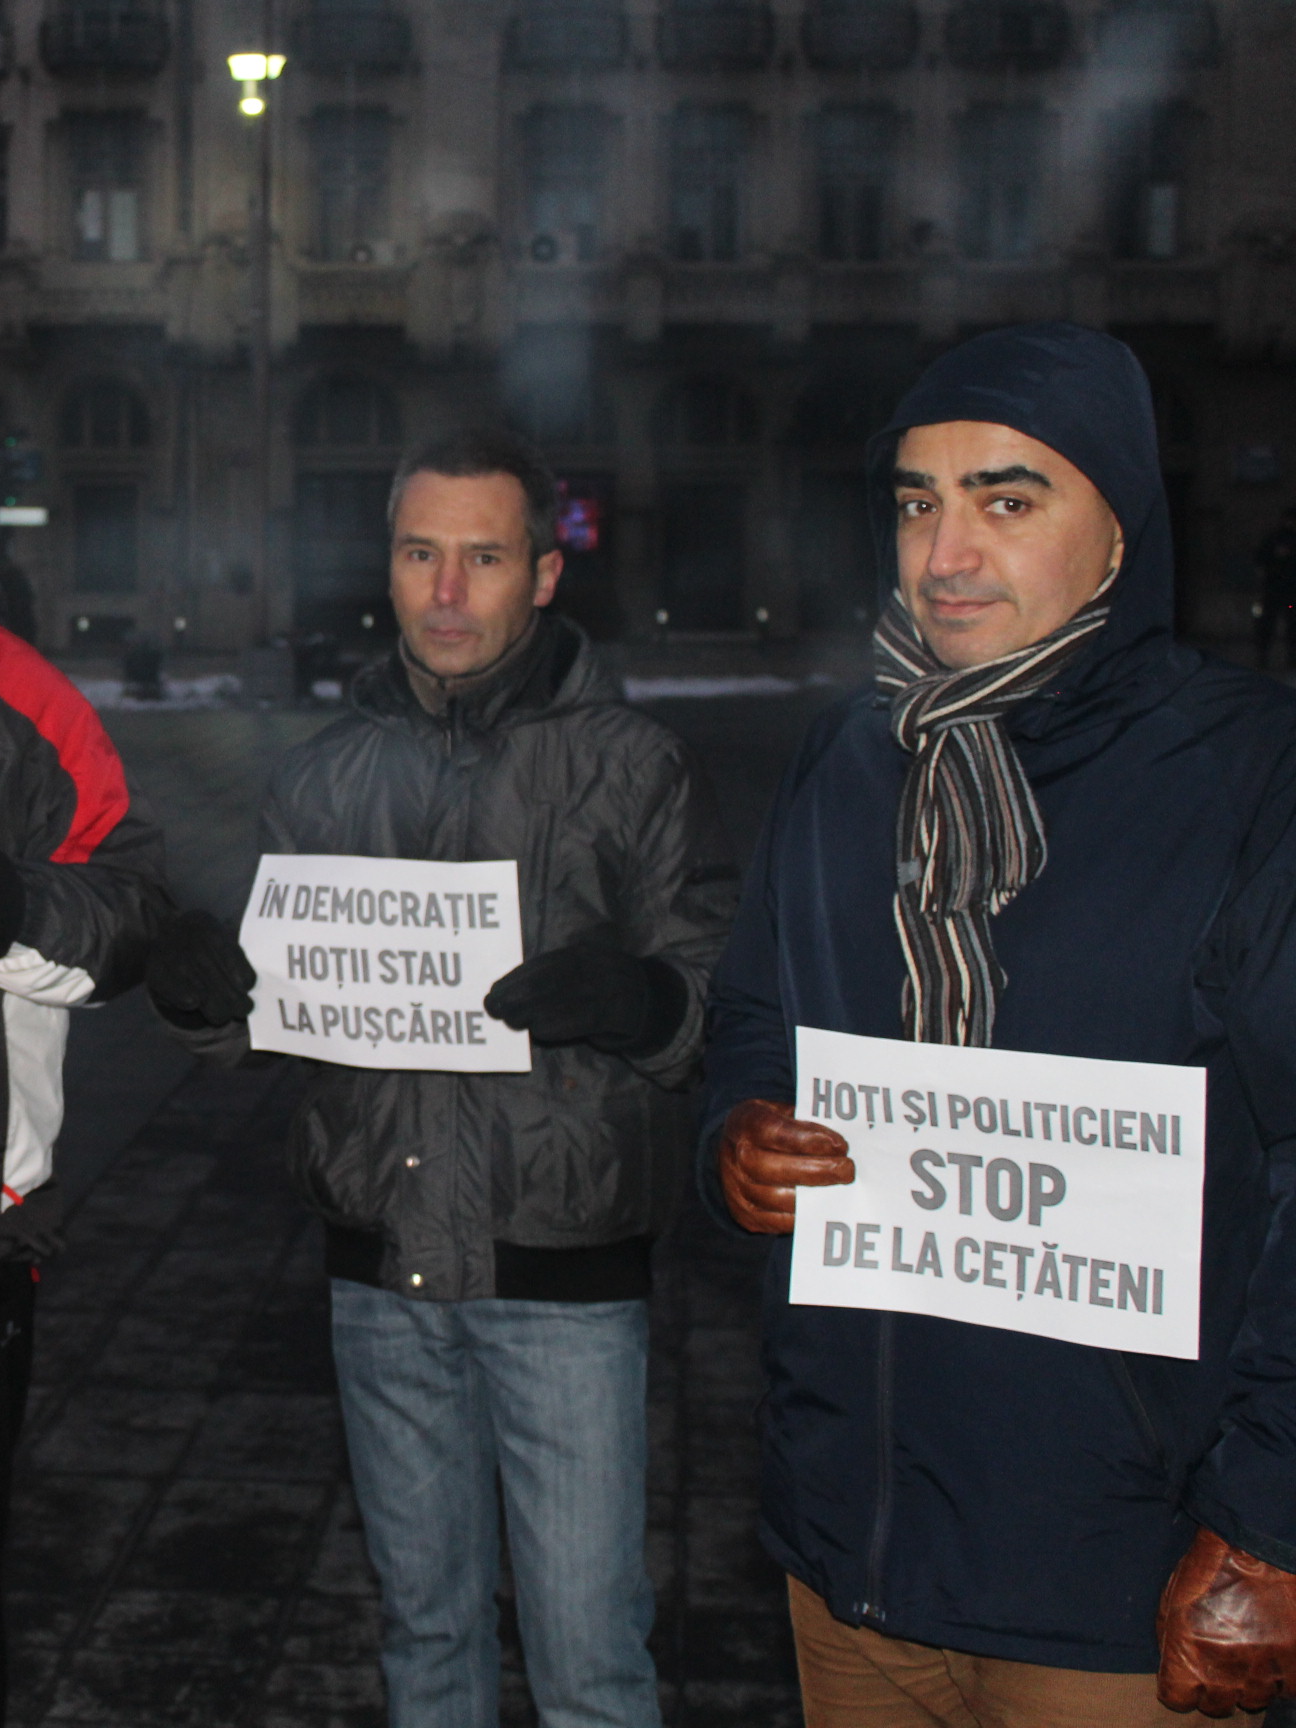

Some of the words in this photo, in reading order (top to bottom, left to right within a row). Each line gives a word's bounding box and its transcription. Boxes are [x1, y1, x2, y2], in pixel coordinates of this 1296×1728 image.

[259, 878, 290, 918] ÎN
[287, 944, 370, 989] HOȚII
[377, 949, 462, 987] STAU
[278, 999, 316, 1035] LA
[812, 1078, 894, 1129] HOȚI
[901, 1090, 938, 1133] ȘI
[947, 1093, 1181, 1156] POLITICIENI
[910, 1148, 1067, 1226] STOP
[823, 1221, 881, 1270] DE
[891, 1226, 944, 1278] LA
